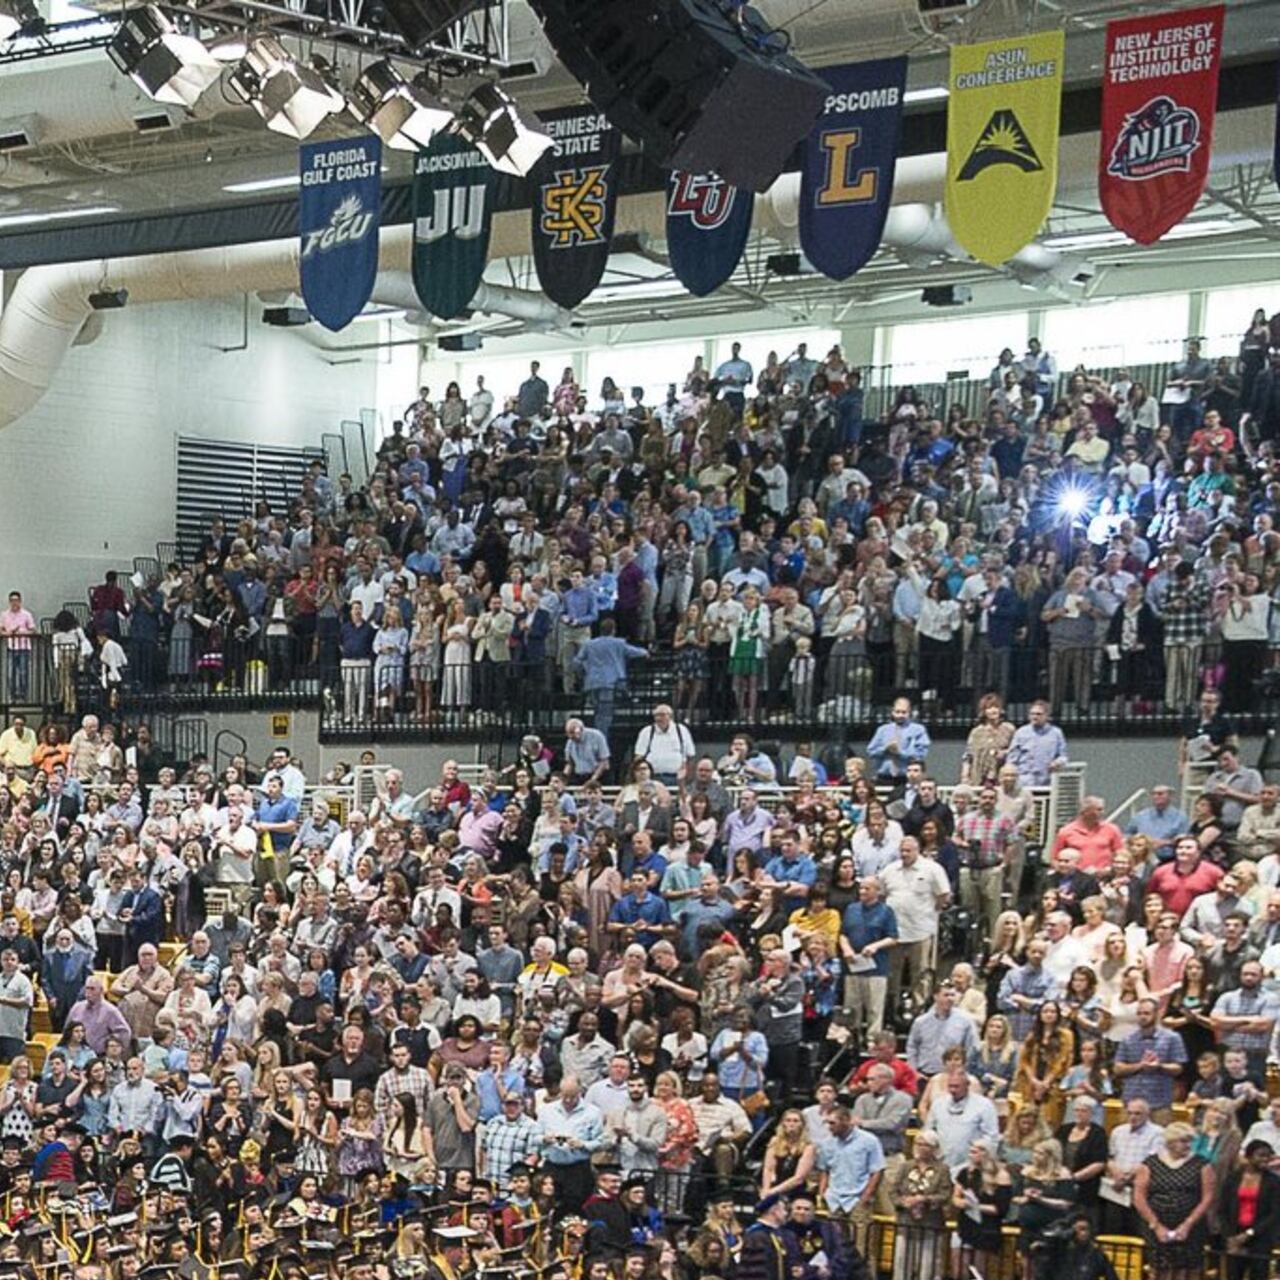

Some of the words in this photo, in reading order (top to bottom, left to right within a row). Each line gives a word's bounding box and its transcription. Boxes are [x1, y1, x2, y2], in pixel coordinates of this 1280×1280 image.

[1115, 33, 1150, 51] NEW
[1152, 22, 1214, 46] JERSEY
[985, 49, 1027, 68] ASUN
[1109, 42, 1190, 69] INSTITUTE
[1195, 38, 1216, 55] OF
[956, 61, 1056, 90] CONFERENCE
[1109, 55, 1214, 83] TECHNOLOGY
[823, 87, 900, 115] PSCOMB
[541, 114, 612, 138] ENNESA
[1128, 119, 1189, 161] NJIT
[314, 147, 366, 168] FLORIDA
[553, 134, 600, 156] STATE
[303, 167, 332, 186] GULF
[337, 161, 377, 181] COAST
[815, 127, 880, 209] L
[416, 185, 486, 243] JU
